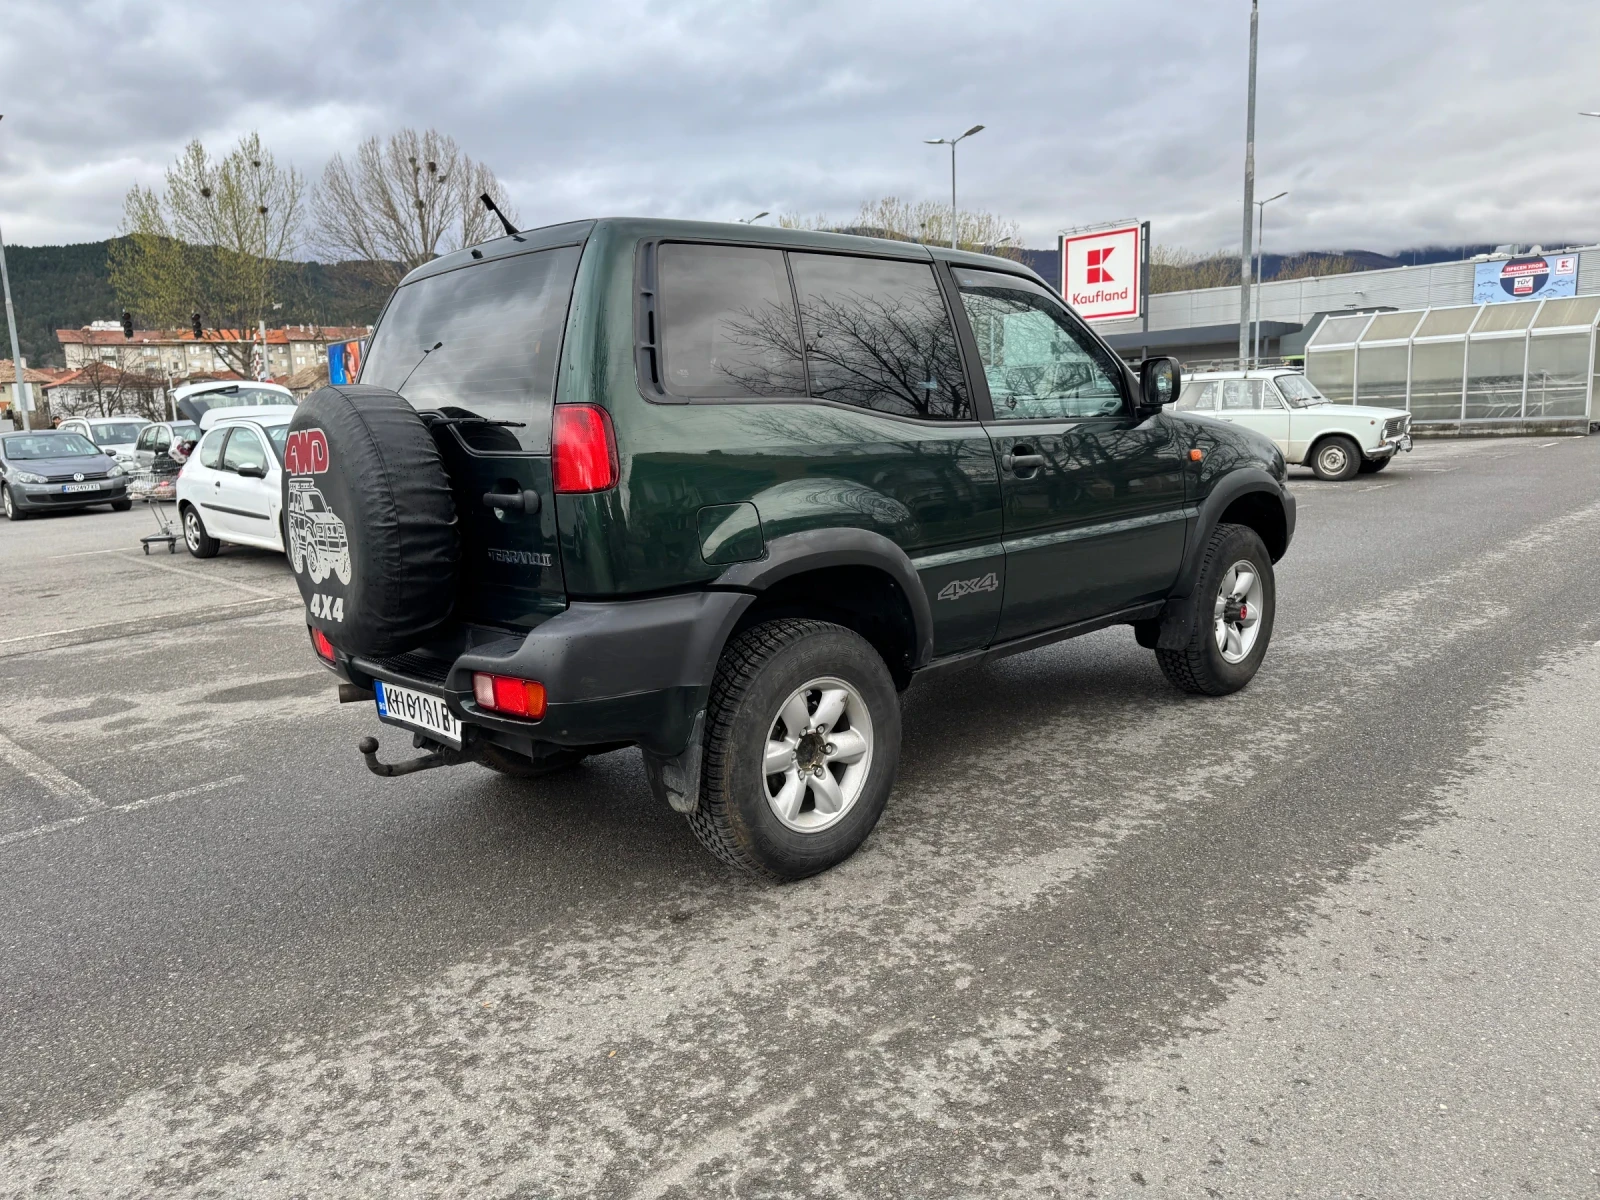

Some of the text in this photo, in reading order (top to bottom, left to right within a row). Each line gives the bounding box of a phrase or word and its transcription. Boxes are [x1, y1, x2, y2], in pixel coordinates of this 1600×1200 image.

[1072, 287, 1128, 304] Kaufland
[284, 428, 329, 476] 4WD
[311, 593, 344, 622] 4X4
